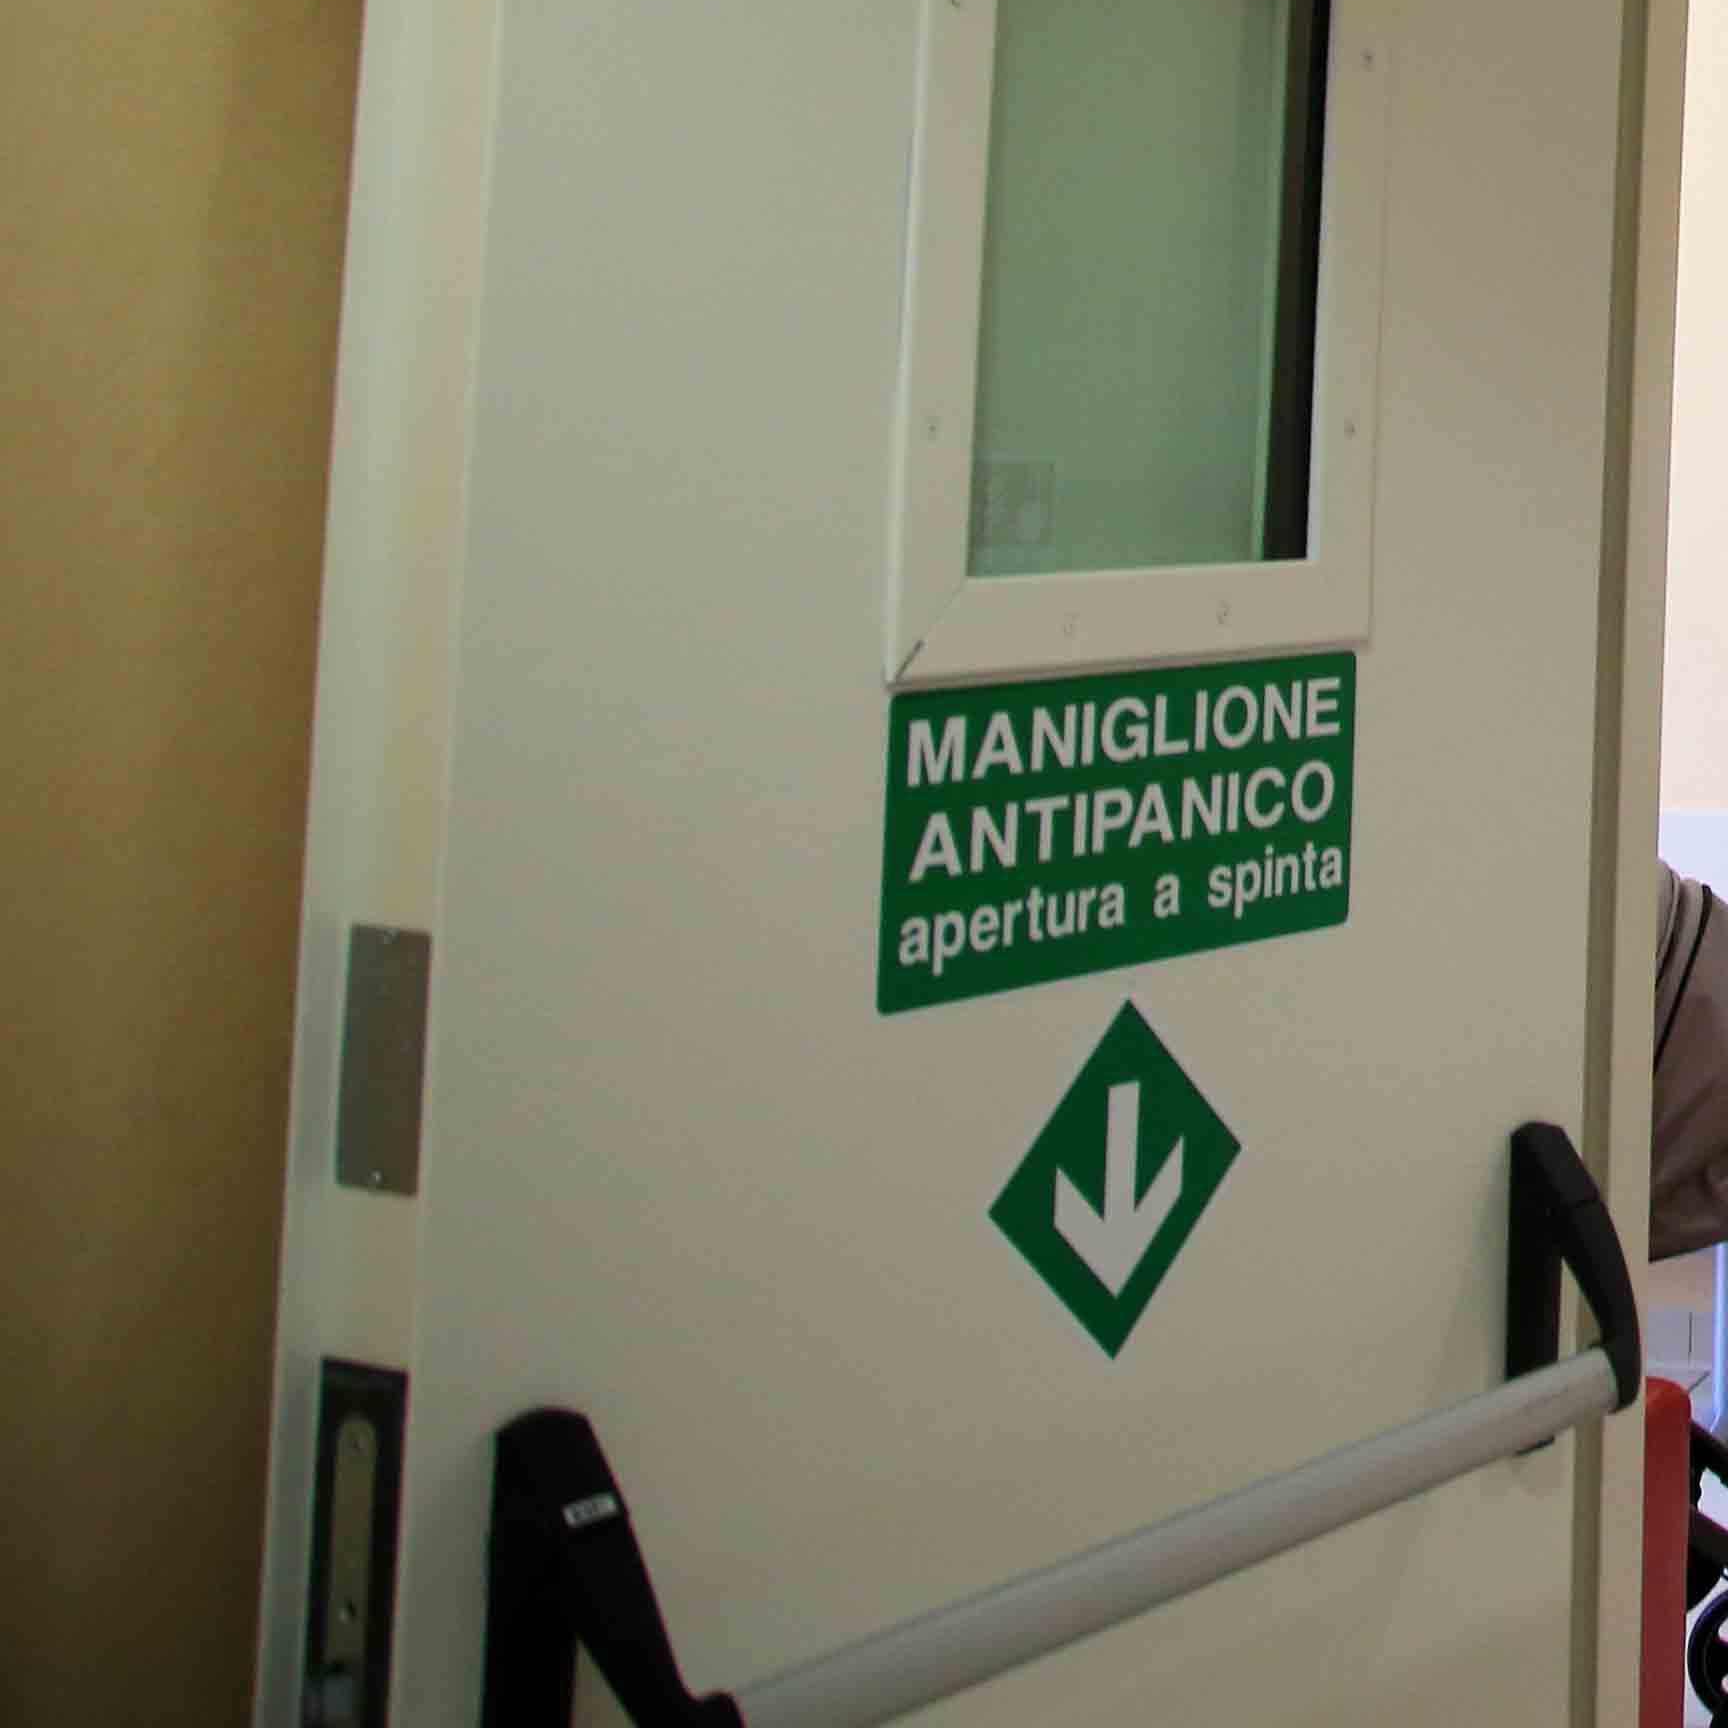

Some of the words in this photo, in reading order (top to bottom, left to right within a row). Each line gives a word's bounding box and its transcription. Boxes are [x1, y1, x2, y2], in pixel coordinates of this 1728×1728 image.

[906, 676, 1341, 787] MANIGLIONE
[909, 760, 1335, 882] ANTIPANICO
[898, 883, 1126, 976] apertura
[1153, 873, 1181, 918] a
[1207, 841, 1343, 919] spinta
